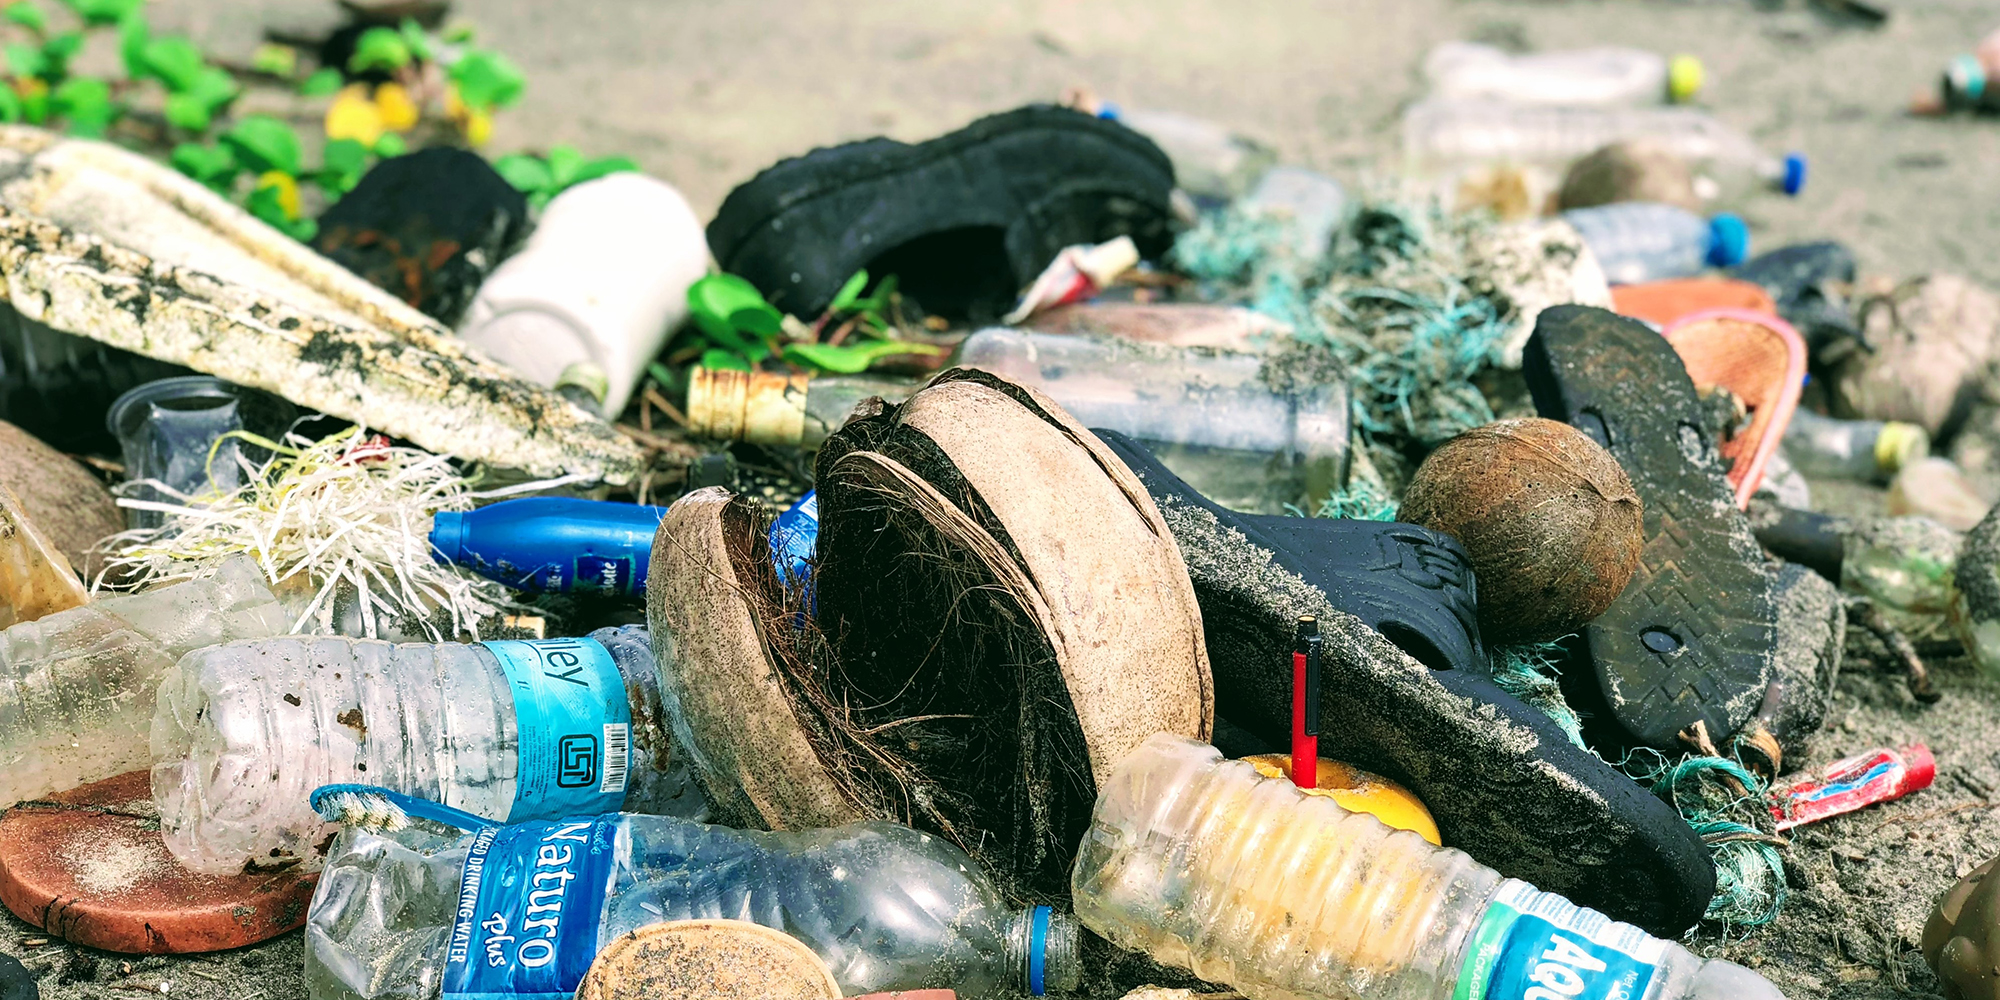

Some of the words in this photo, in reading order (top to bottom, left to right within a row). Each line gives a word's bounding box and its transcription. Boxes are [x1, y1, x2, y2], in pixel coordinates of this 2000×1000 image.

[458, 857, 484, 918] DRINKING
[518, 822, 592, 967] Naturo
[450, 922, 472, 963] WATER
[482, 912, 515, 967] plus
[1468, 942, 1491, 1000] PACKAGE
[1622, 969, 1640, 988] Net
